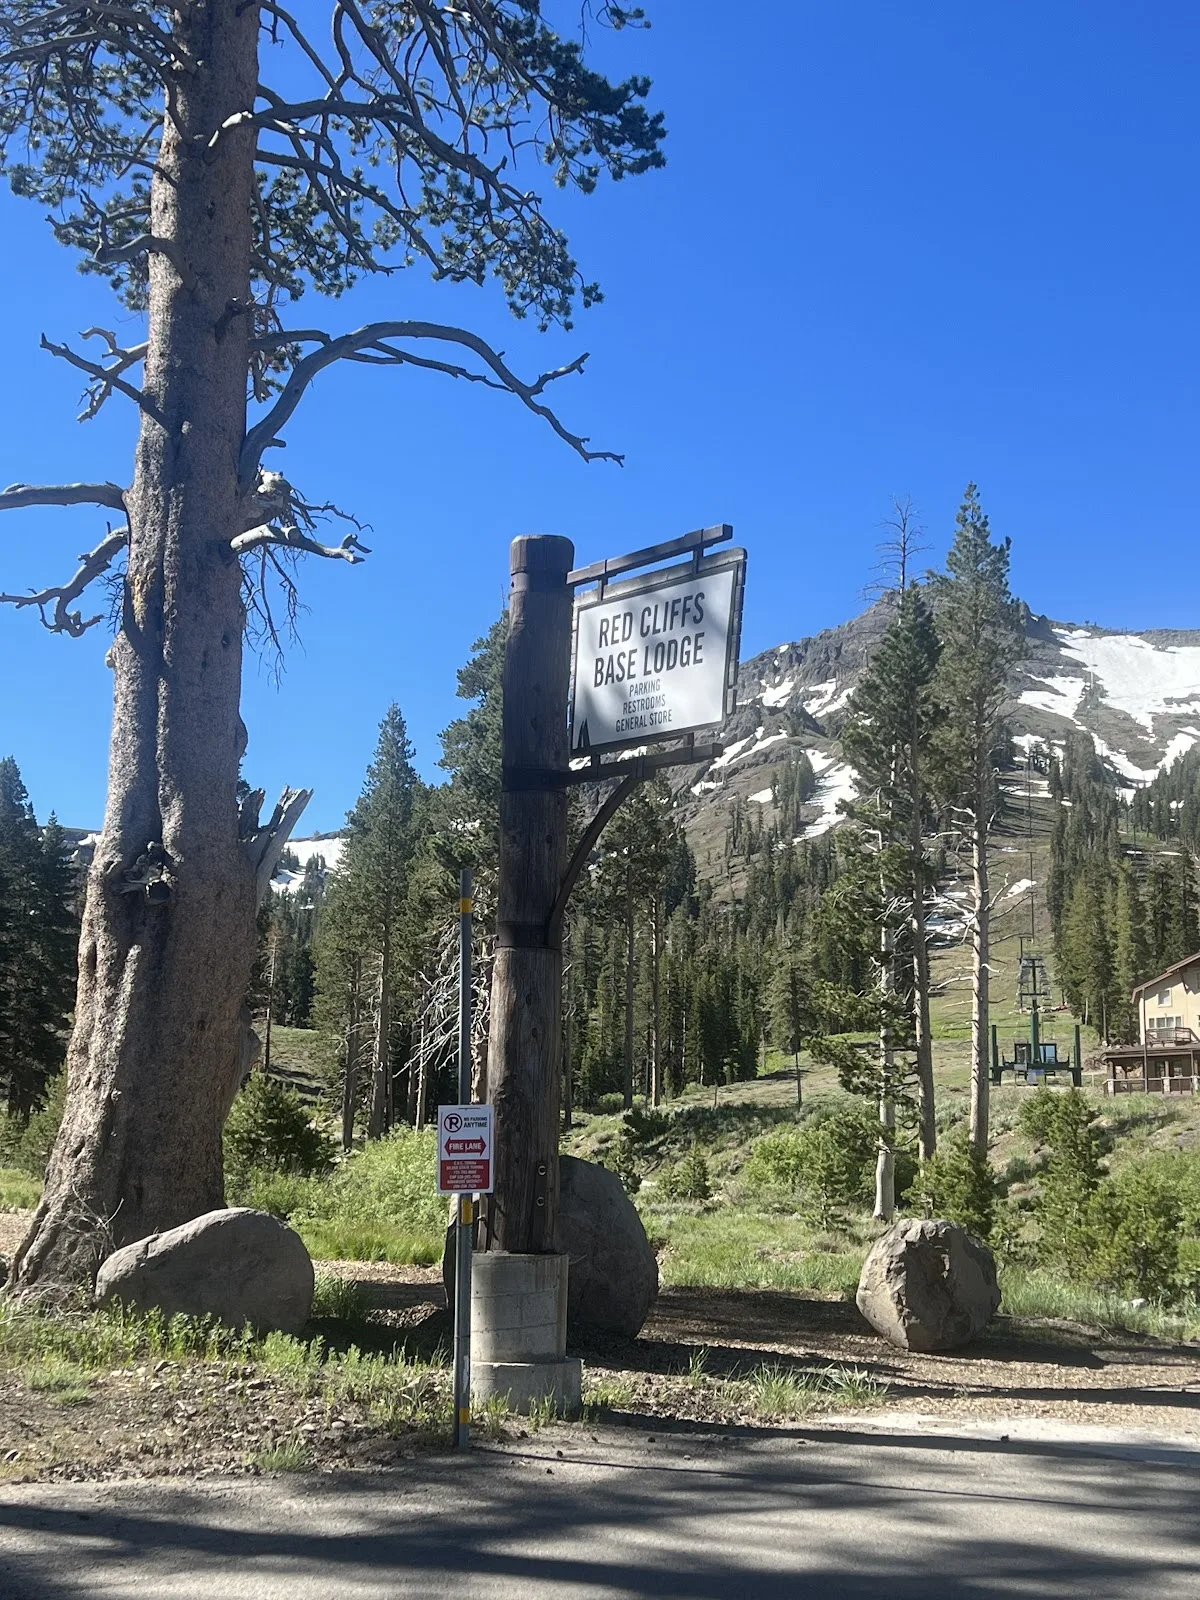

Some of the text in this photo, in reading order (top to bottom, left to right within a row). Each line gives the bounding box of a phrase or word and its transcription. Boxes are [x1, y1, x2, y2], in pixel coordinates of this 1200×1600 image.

[599, 592, 705, 648] RED CLIFFS
[594, 632, 705, 687] BASE LODGE
[629, 679, 660, 697] PARKING
[623, 694, 666, 715] RESTROOMS
[616, 709, 672, 732] GENERAL STORE
[465, 1142, 482, 1150] LANE
